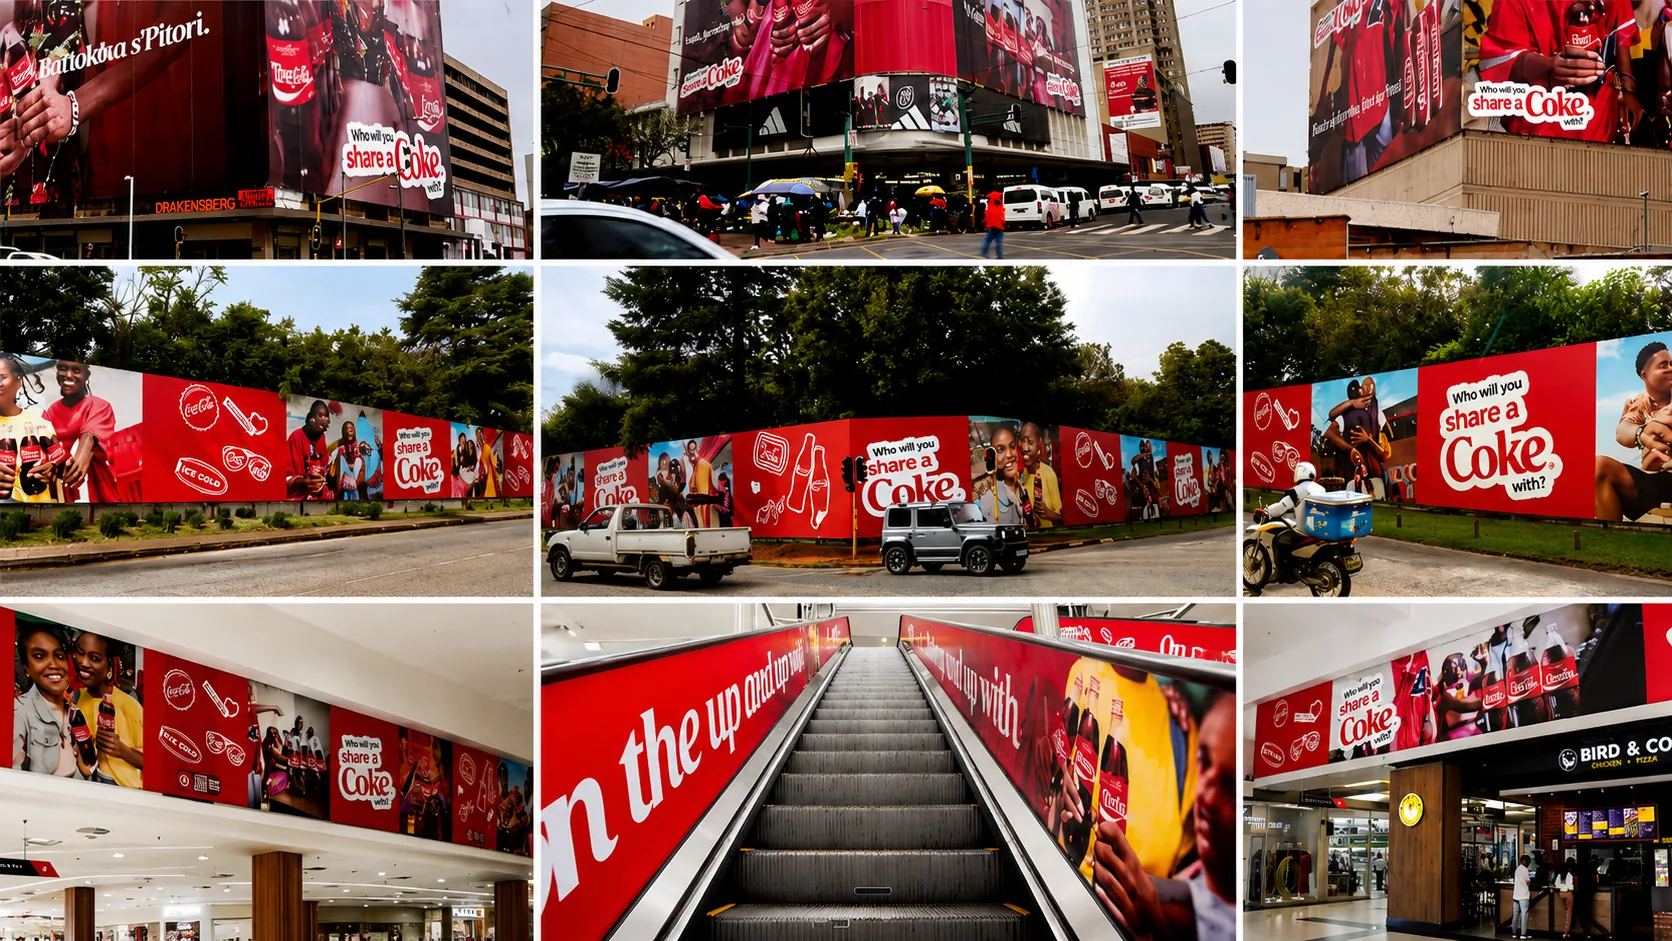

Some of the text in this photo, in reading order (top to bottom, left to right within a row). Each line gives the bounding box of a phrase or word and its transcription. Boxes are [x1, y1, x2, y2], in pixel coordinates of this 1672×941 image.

[130, 11, 210, 55] s'Pitori.
[708, 60, 740, 87] Coke
[1473, 95, 1523, 110] share a
[1480, 86, 1498, 94] Who
[1525, 91, 1585, 117] Coke
[351, 128, 370, 142] Who
[346, 144, 394, 169] share a
[395, 137, 440, 181] Coke
[155, 198, 236, 214] DRAKENSBERG
[1452, 379, 1522, 404] Who will you
[1445, 401, 1520, 432] share a
[397, 442, 428, 455] share a
[872, 440, 935, 457] Who will you
[1446, 430, 1547, 482] Coke
[181, 465, 220, 487] ICE COLD
[397, 457, 439, 485] Coke
[868, 455, 933, 476] share a
[867, 473, 954, 512] Coke
[1512, 476, 1546, 493] with?
[963, 665, 977, 715] up
[979, 666, 1020, 750] with
[1339, 690, 1379, 716] share a
[1340, 708, 1393, 746] Coke
[345, 739, 358, 748] Who
[1580, 736, 1672, 762] BIRD & CO
[342, 750, 378, 764] share a
[1636, 755, 1658, 764] PIZZA
[342, 766, 390, 796] Coke
[541, 777, 619, 917] n
[619, 707, 702, 824] the
[705, 683, 741, 754] up
[774, 654, 789, 694] up
